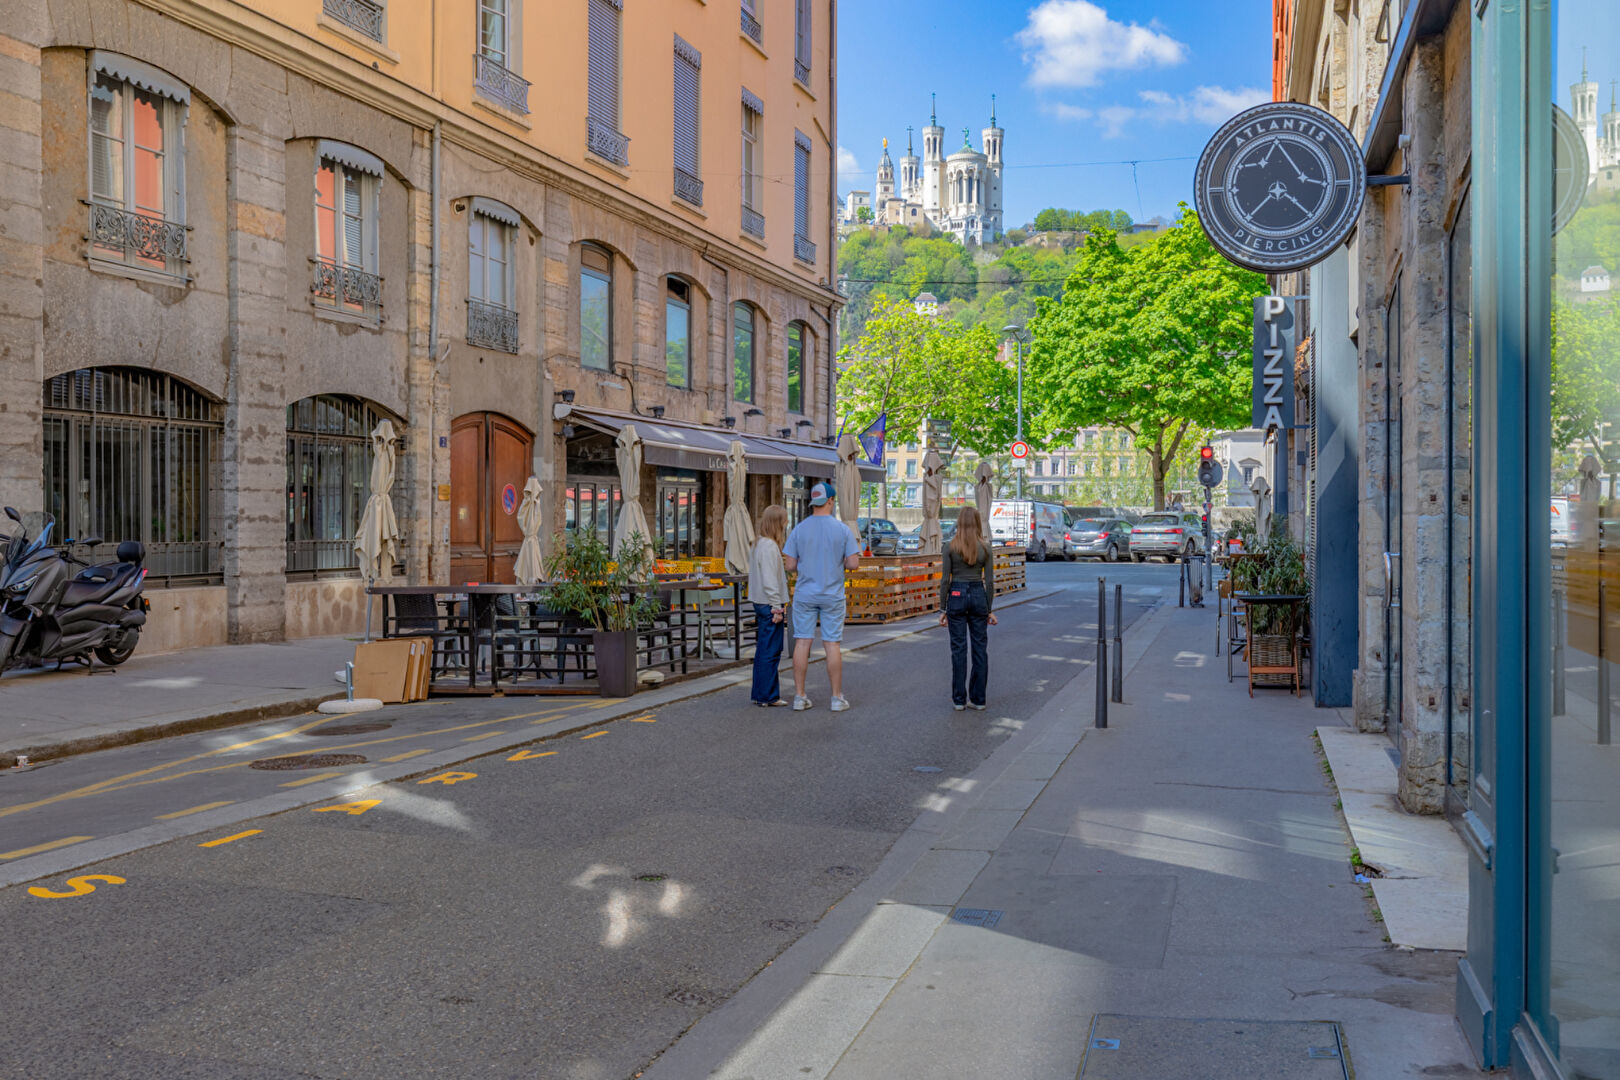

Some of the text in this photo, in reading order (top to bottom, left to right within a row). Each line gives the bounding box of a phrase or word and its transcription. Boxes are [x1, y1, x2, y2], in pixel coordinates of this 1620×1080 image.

[1234, 118, 1327, 147] ATLANTIS
[1234, 226, 1324, 252] PIERCING
[1262, 296, 1286, 430] PIZZA
